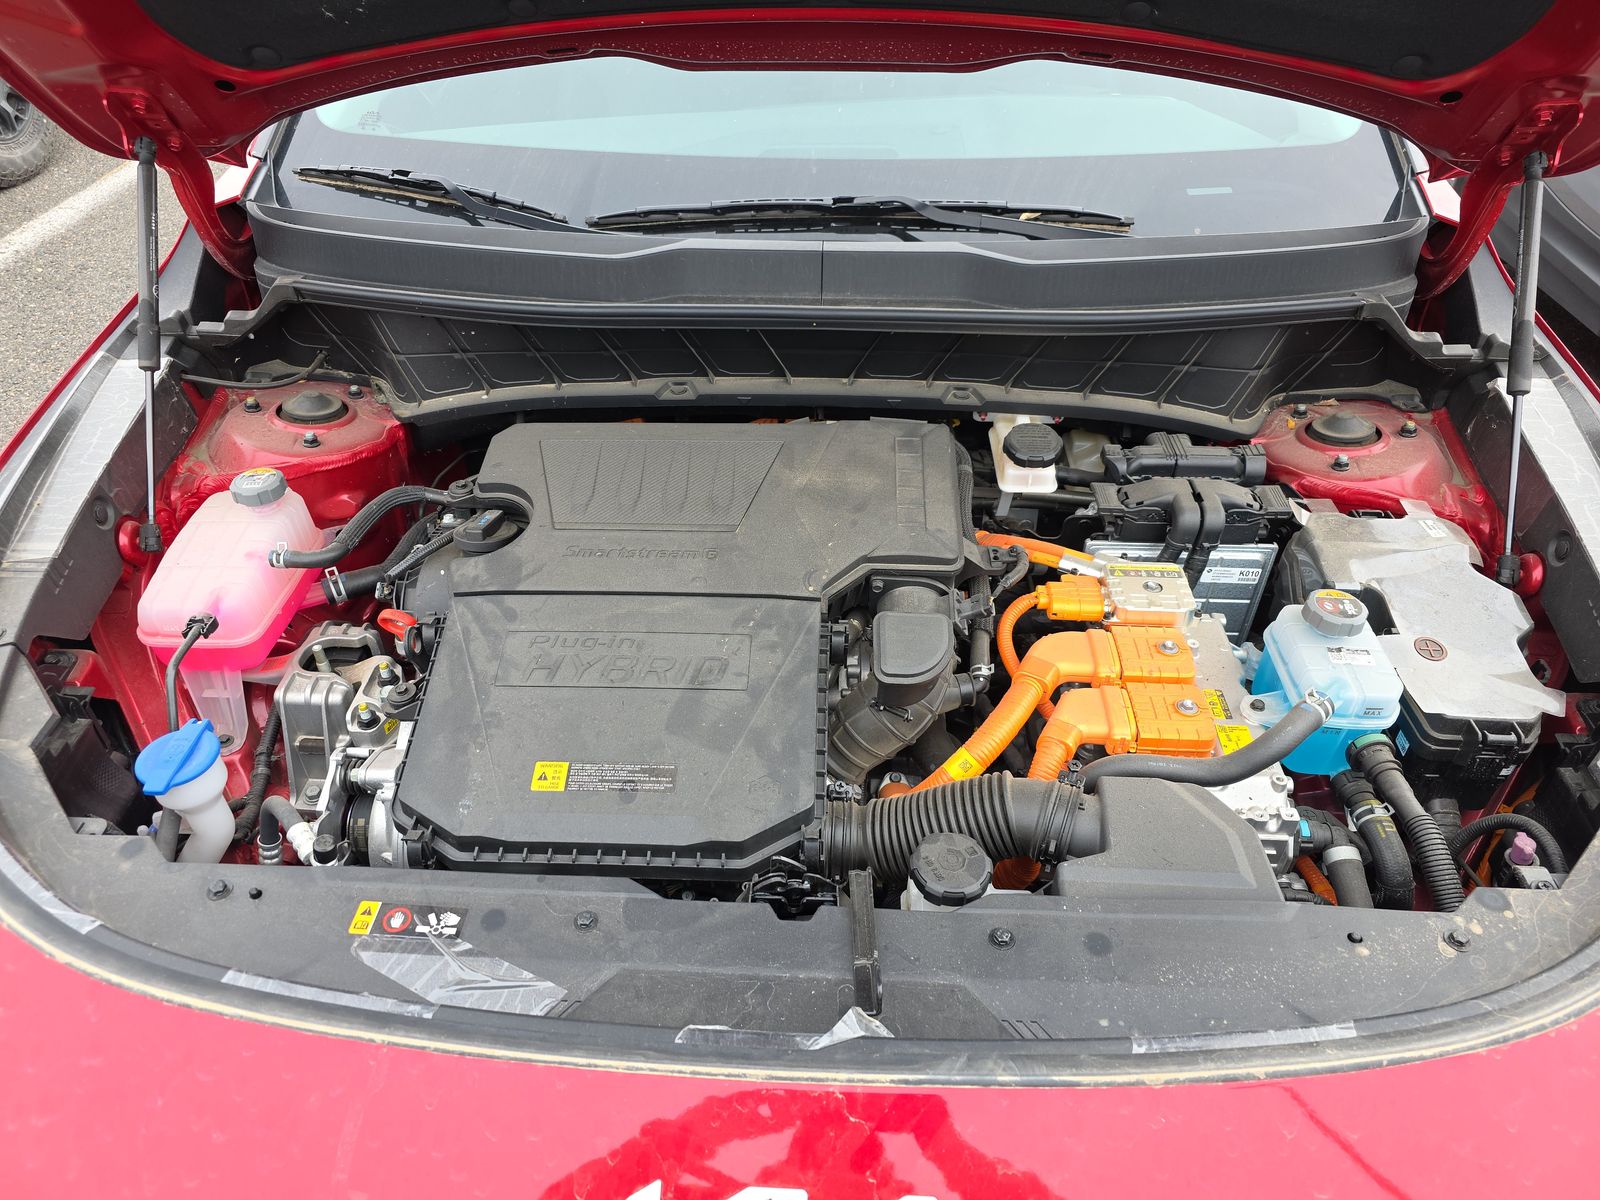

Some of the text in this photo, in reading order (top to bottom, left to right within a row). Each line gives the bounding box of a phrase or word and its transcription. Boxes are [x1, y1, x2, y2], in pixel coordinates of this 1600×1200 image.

[562, 544, 719, 560] Smartstream G
[1239, 569, 1260, 578] K010
[528, 635, 637, 650] Plug-in
[523, 653, 730, 687] HYBRID
